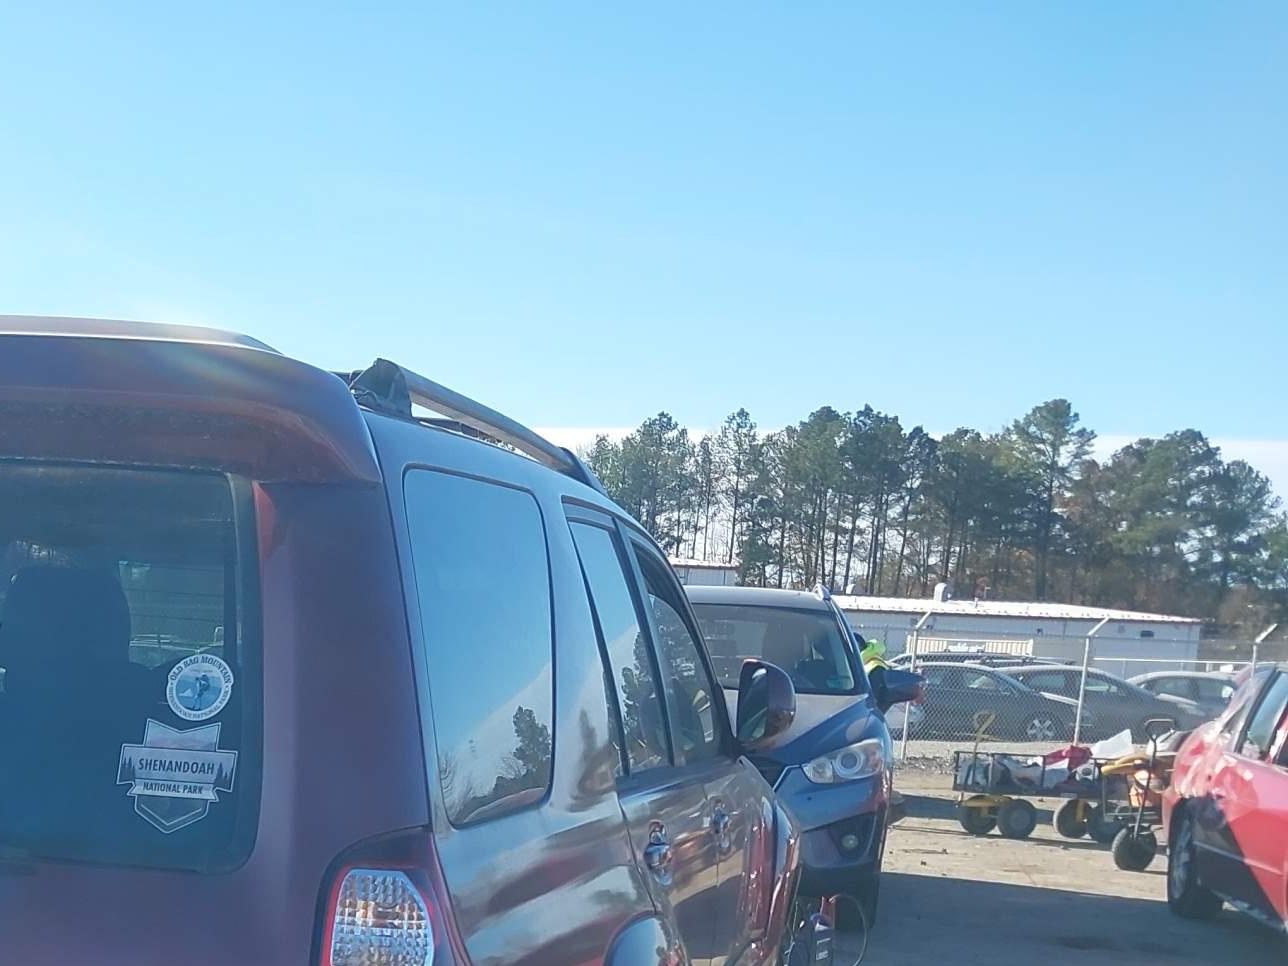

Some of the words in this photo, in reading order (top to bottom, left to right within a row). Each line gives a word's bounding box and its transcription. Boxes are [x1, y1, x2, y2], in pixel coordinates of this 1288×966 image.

[169, 665, 183, 681] OLD
[200, 655, 232, 684] MOUNTAIN
[138, 758, 215, 775] SHENANDOAH
[143, 782, 181, 793] NATIONAL
[182, 784, 204, 794] PARK
